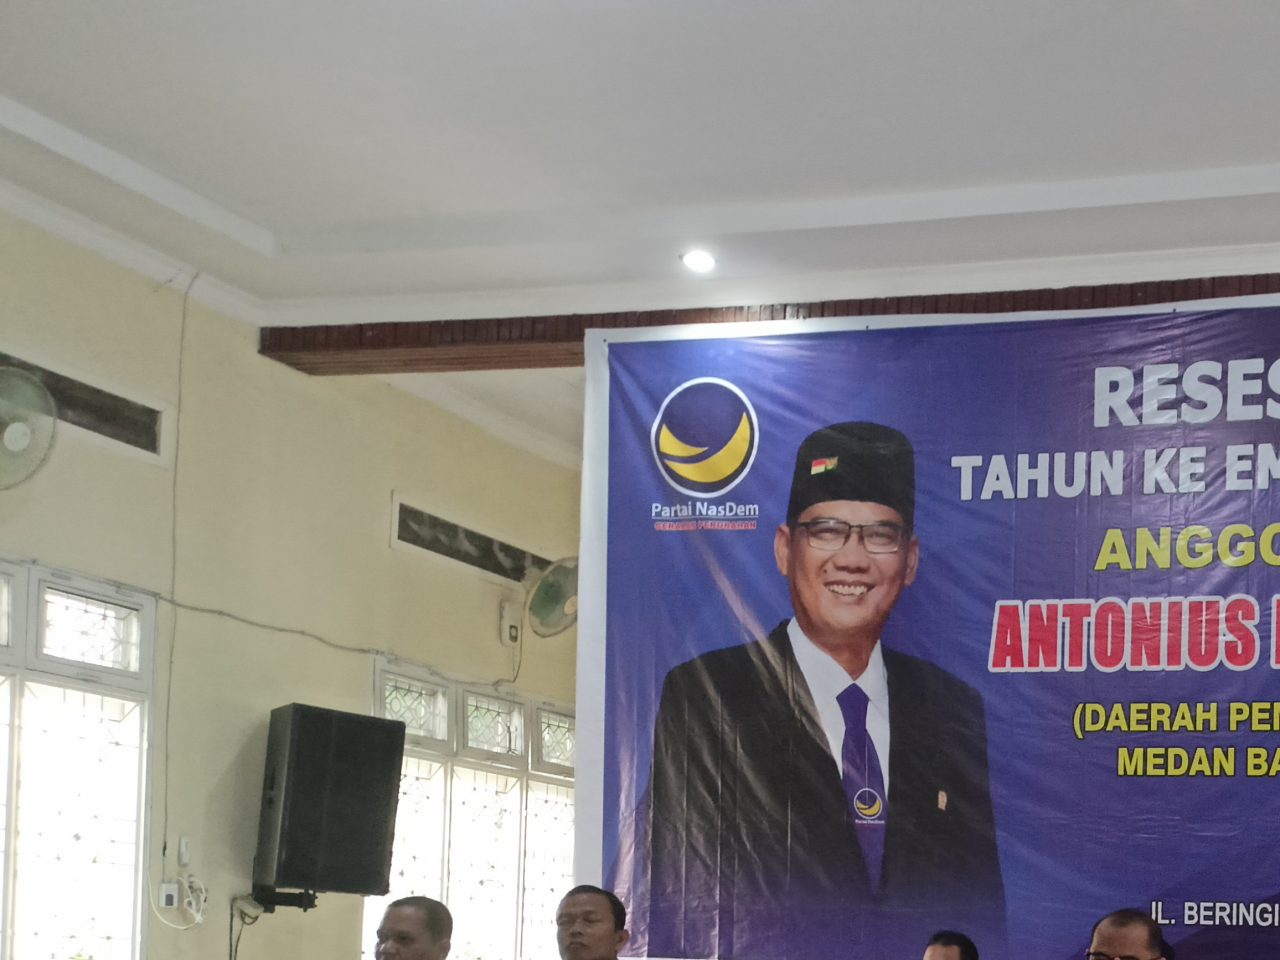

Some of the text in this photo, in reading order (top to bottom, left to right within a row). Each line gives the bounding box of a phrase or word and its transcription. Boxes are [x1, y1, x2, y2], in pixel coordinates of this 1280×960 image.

[951, 450, 1124, 500] TAHUN
[1143, 446, 1206, 494] KE
[651, 501, 759, 517] Partai NasDem
[988, 596, 1260, 673] ANTONIUS
[1073, 702, 1218, 738] (DAERAH
[1117, 747, 1236, 776] MEDAN
